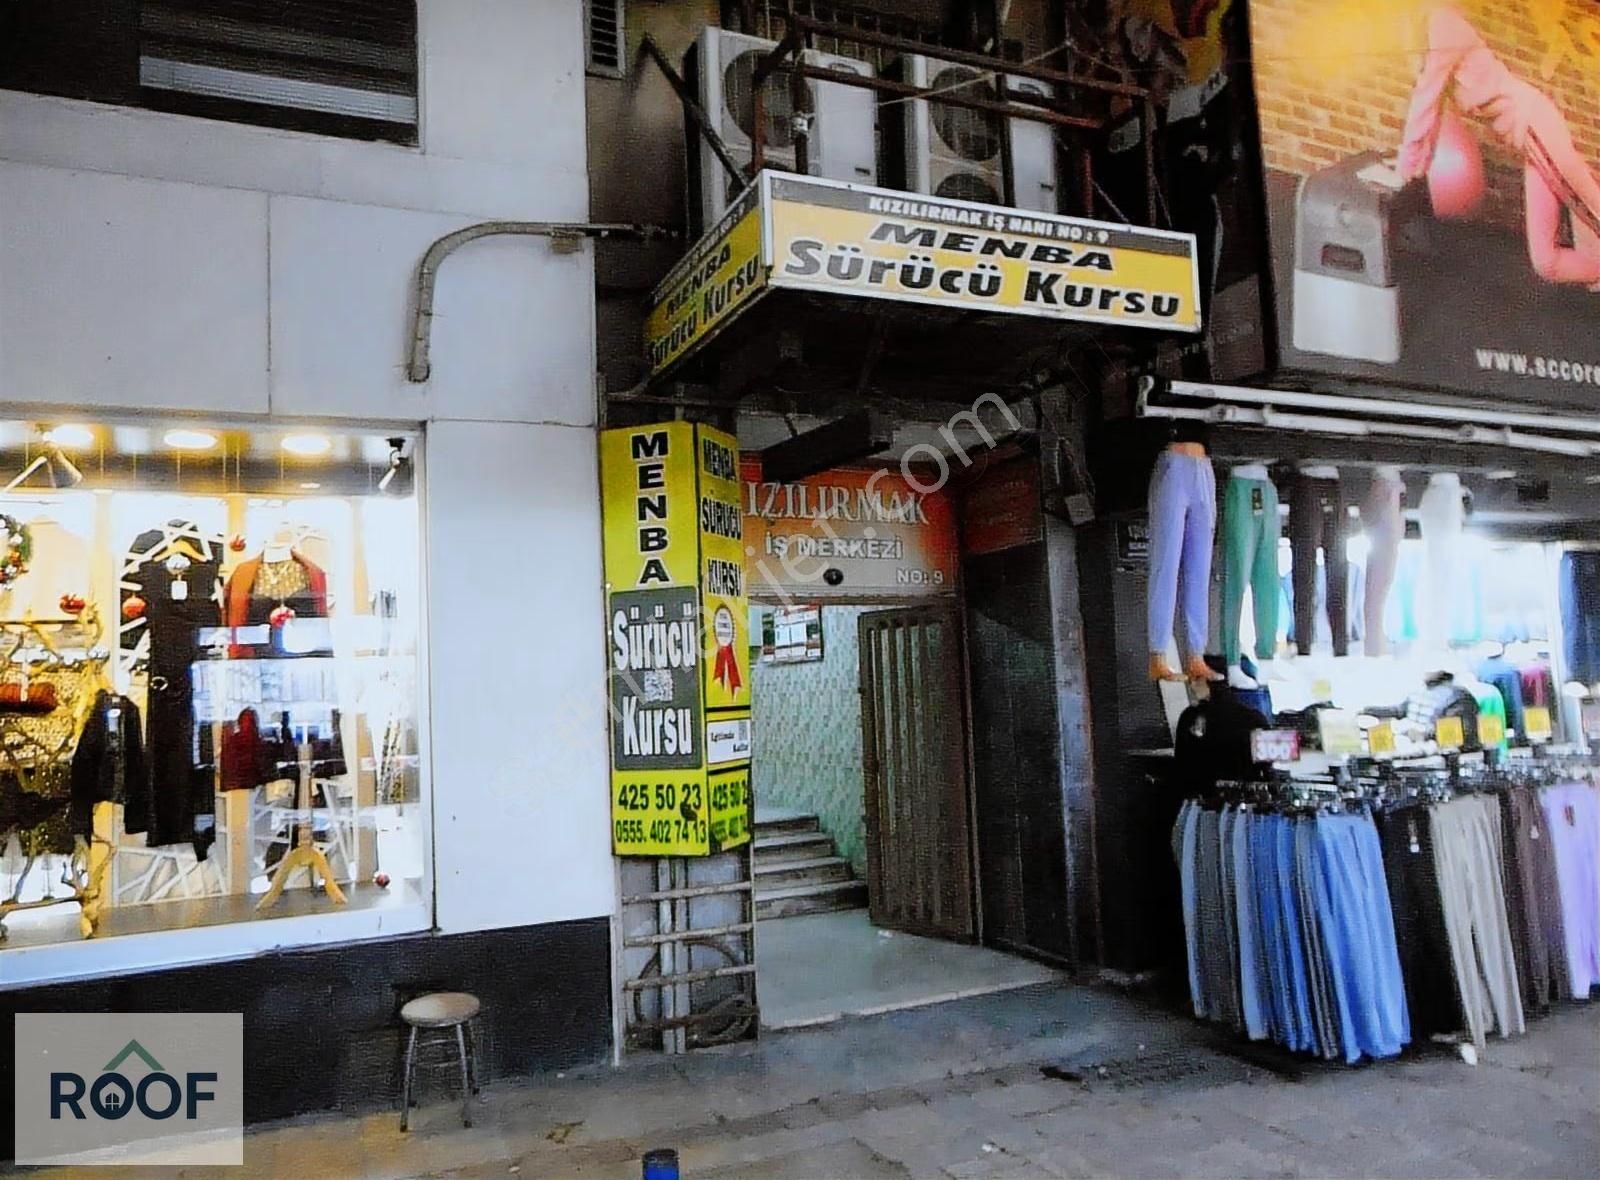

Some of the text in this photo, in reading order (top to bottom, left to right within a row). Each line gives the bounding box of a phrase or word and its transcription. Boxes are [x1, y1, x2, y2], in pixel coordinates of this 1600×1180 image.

[870, 222, 1113, 271] MENBA
[1055, 223, 1082, 243] NO
[703, 252, 760, 325] Kursu
[784, 238, 1003, 299] Sürücü
[1023, 270, 1180, 318] Kursu
[631, 431, 670, 584] MENBA
[742, 479, 930, 526] IZILIRMAK
[764, 531, 903, 560] İŞ MERKEZİ
[613, 602, 696, 671] Sürücü
[621, 696, 693, 756] Kursu
[618, 783, 702, 811] 425 50 23
[615, 819, 647, 843] 0555.
[650, 819, 671, 843] 402
[674, 818, 690, 843] 74
[693, 819, 707, 843] 13
